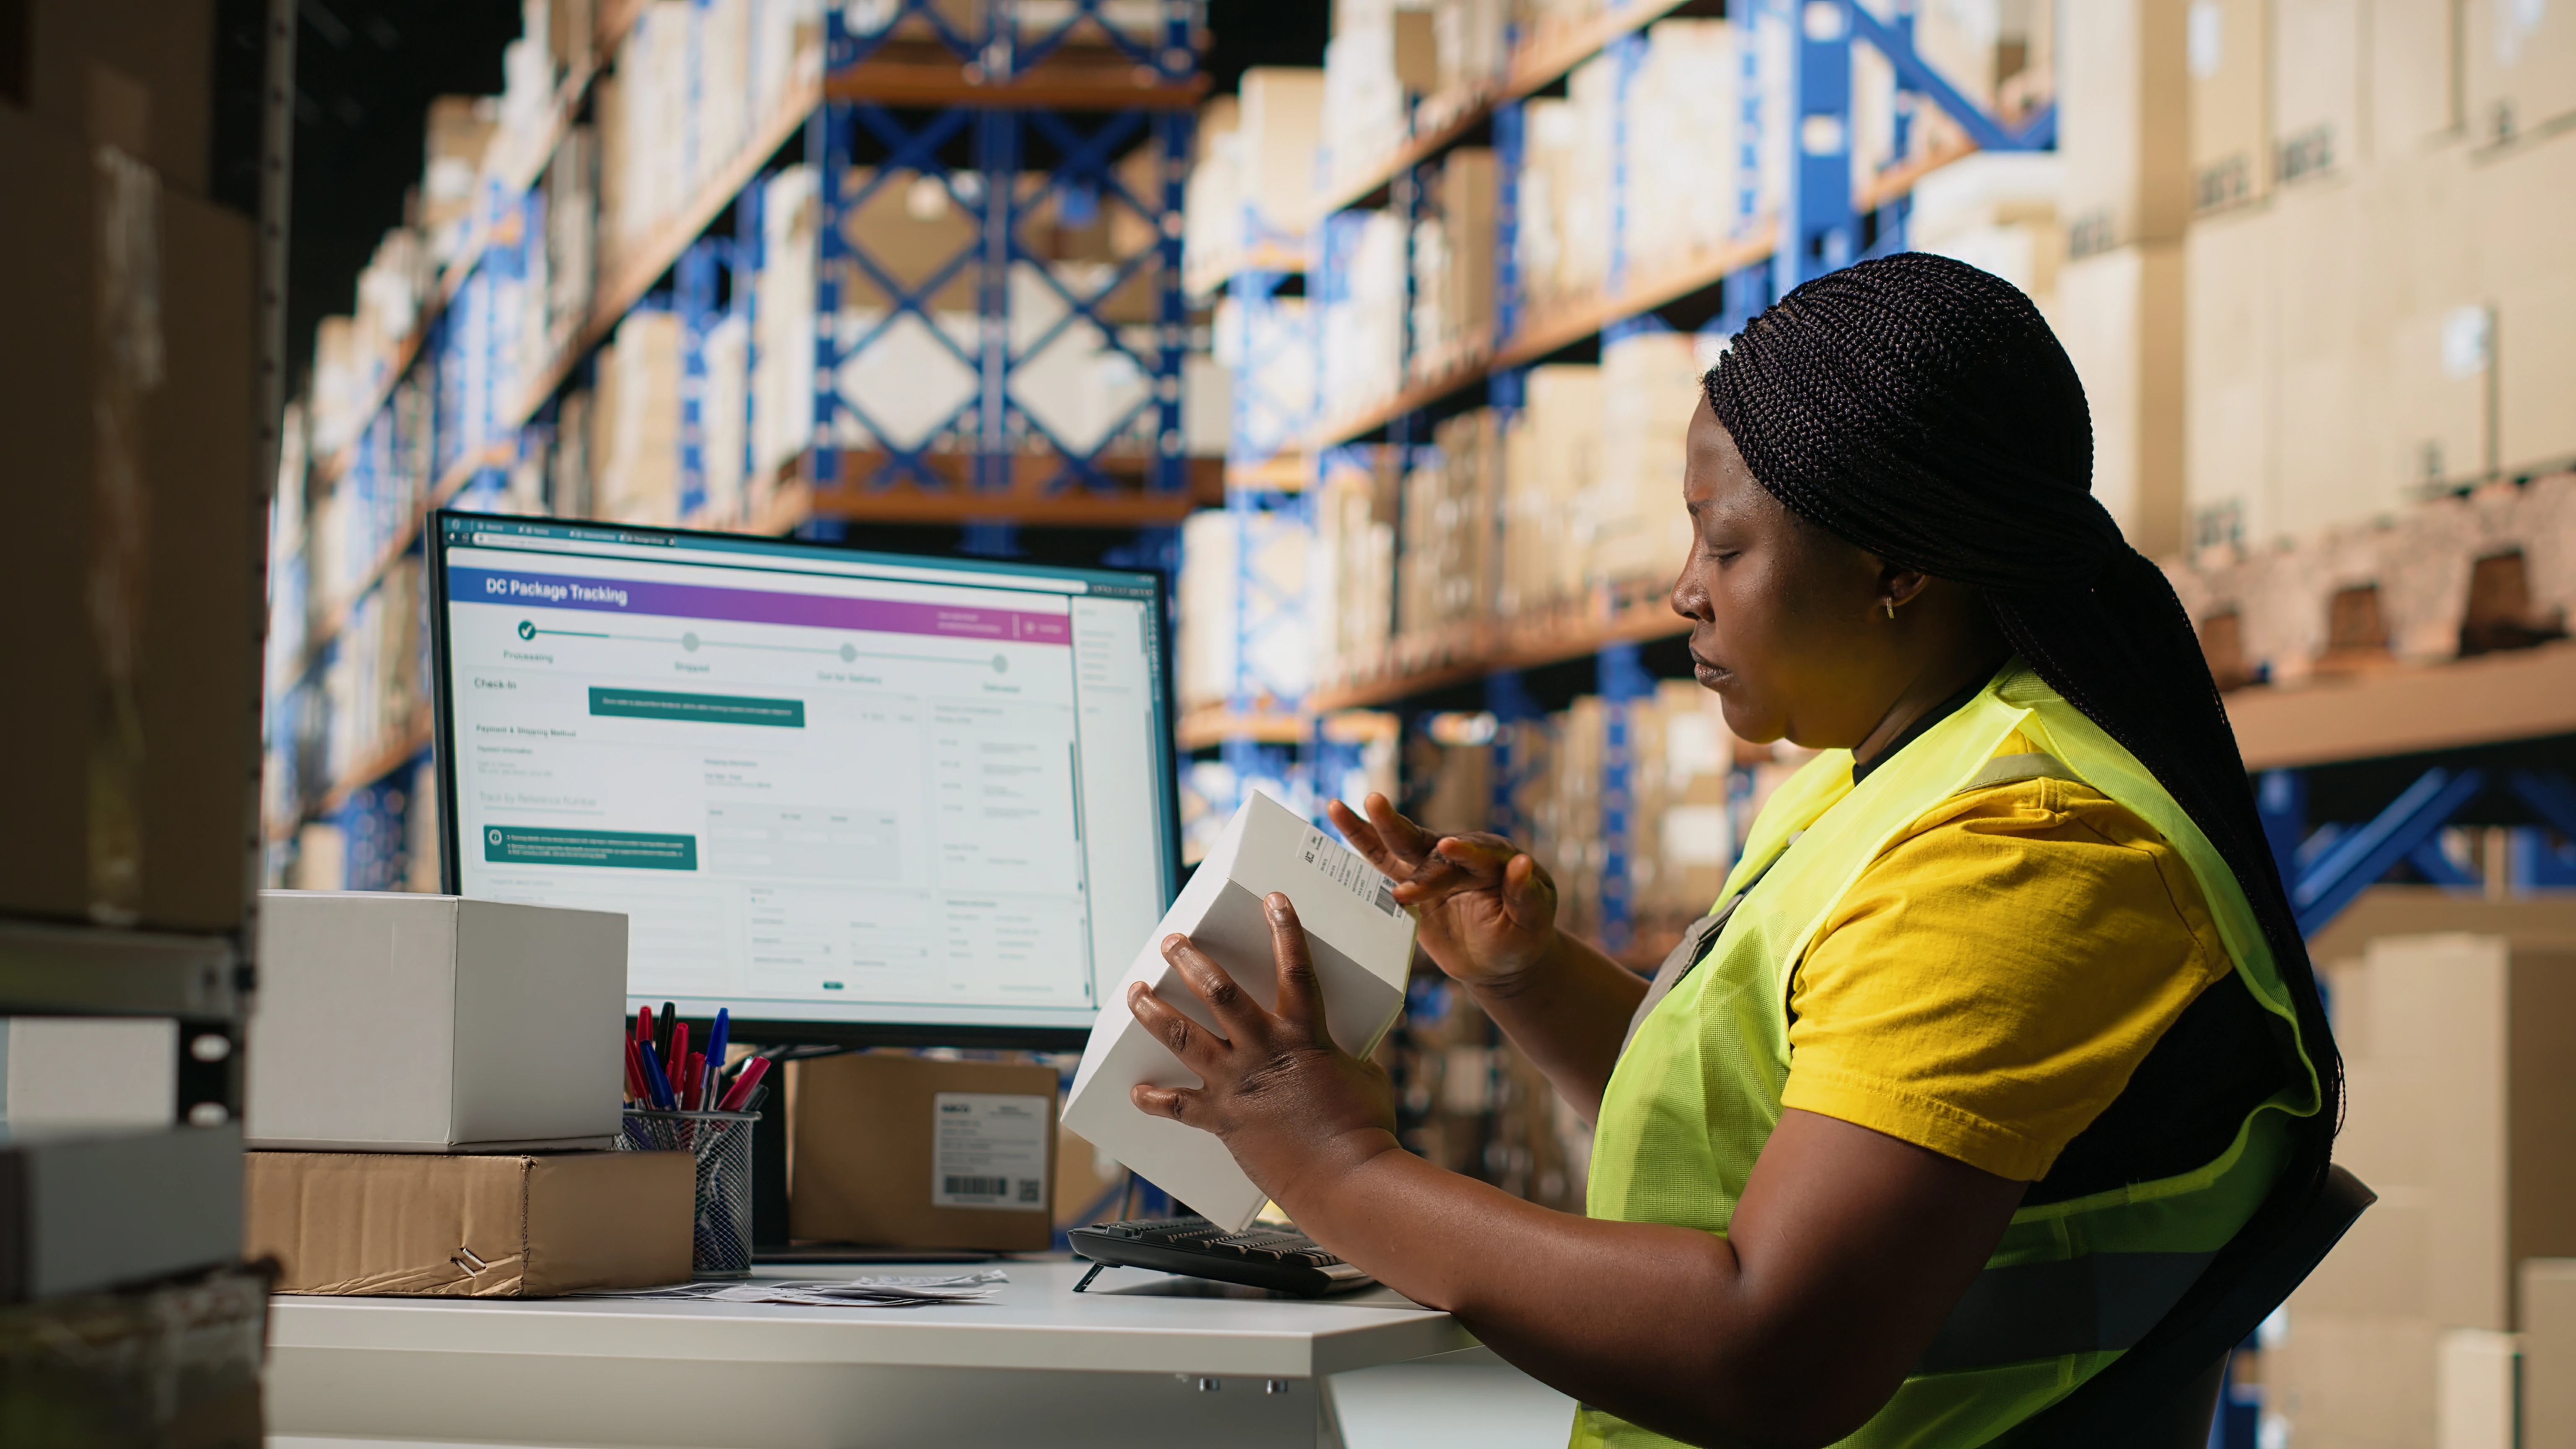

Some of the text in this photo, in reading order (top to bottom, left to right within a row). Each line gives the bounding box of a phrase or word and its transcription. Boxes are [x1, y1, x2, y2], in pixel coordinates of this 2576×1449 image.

[486, 578, 628, 607] DC Package Tracking
[504, 649, 553, 664] Processing
[477, 724, 506, 733] Payment
[517, 726, 548, 738] Shipping
